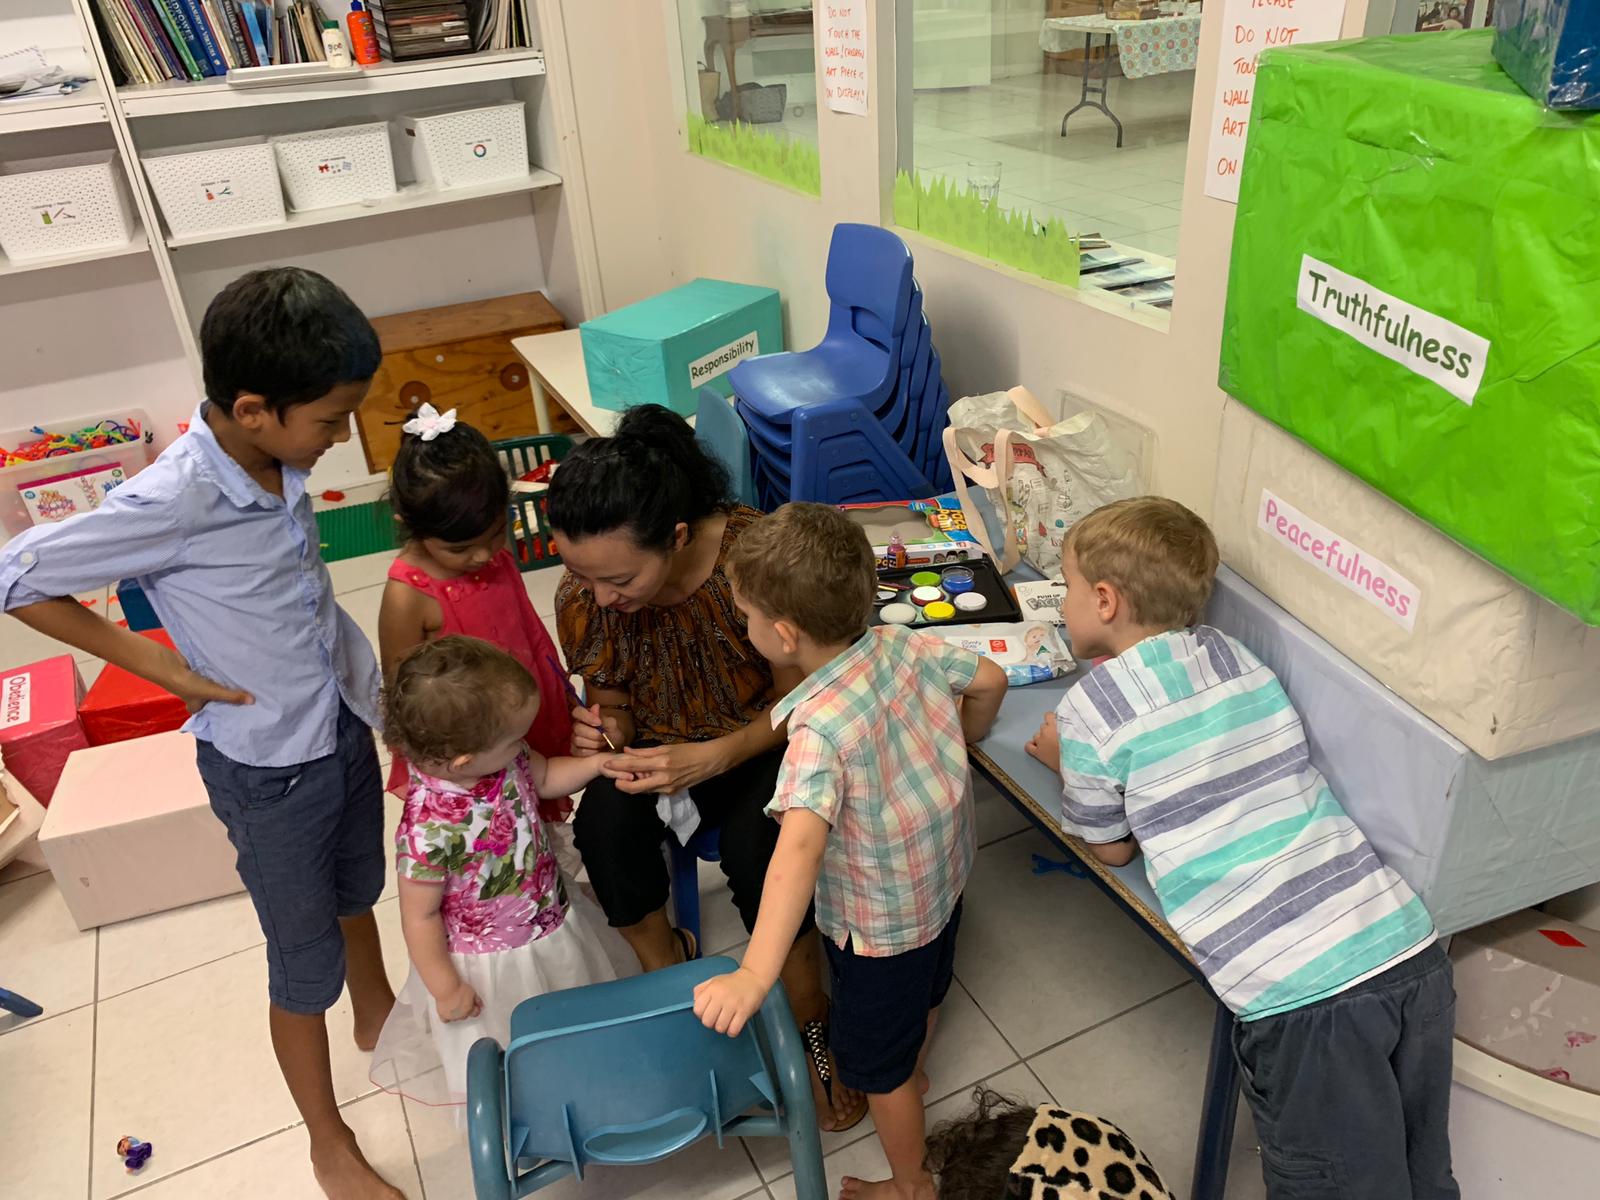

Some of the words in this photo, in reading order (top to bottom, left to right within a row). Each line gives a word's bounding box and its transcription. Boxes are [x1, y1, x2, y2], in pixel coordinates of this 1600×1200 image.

[828, 6, 836, 18] DO
[839, 8, 851, 17] NOT
[828, 27, 848, 39] TOUCH
[851, 29, 861, 40] THE
[1235, 25, 1255, 44] DO
[1265, 28, 1299, 45] NOT
[826, 66, 836, 77] ART
[1223, 89, 1250, 106] WALL
[1222, 117, 1247, 136] ART
[1217, 158, 1238, 175] ON
[1308, 269, 1473, 379] Truthfulness
[691, 339, 755, 380] Responsibility
[1265, 498, 1411, 617] Peacefulness
[7, 676, 26, 723] Obedience
